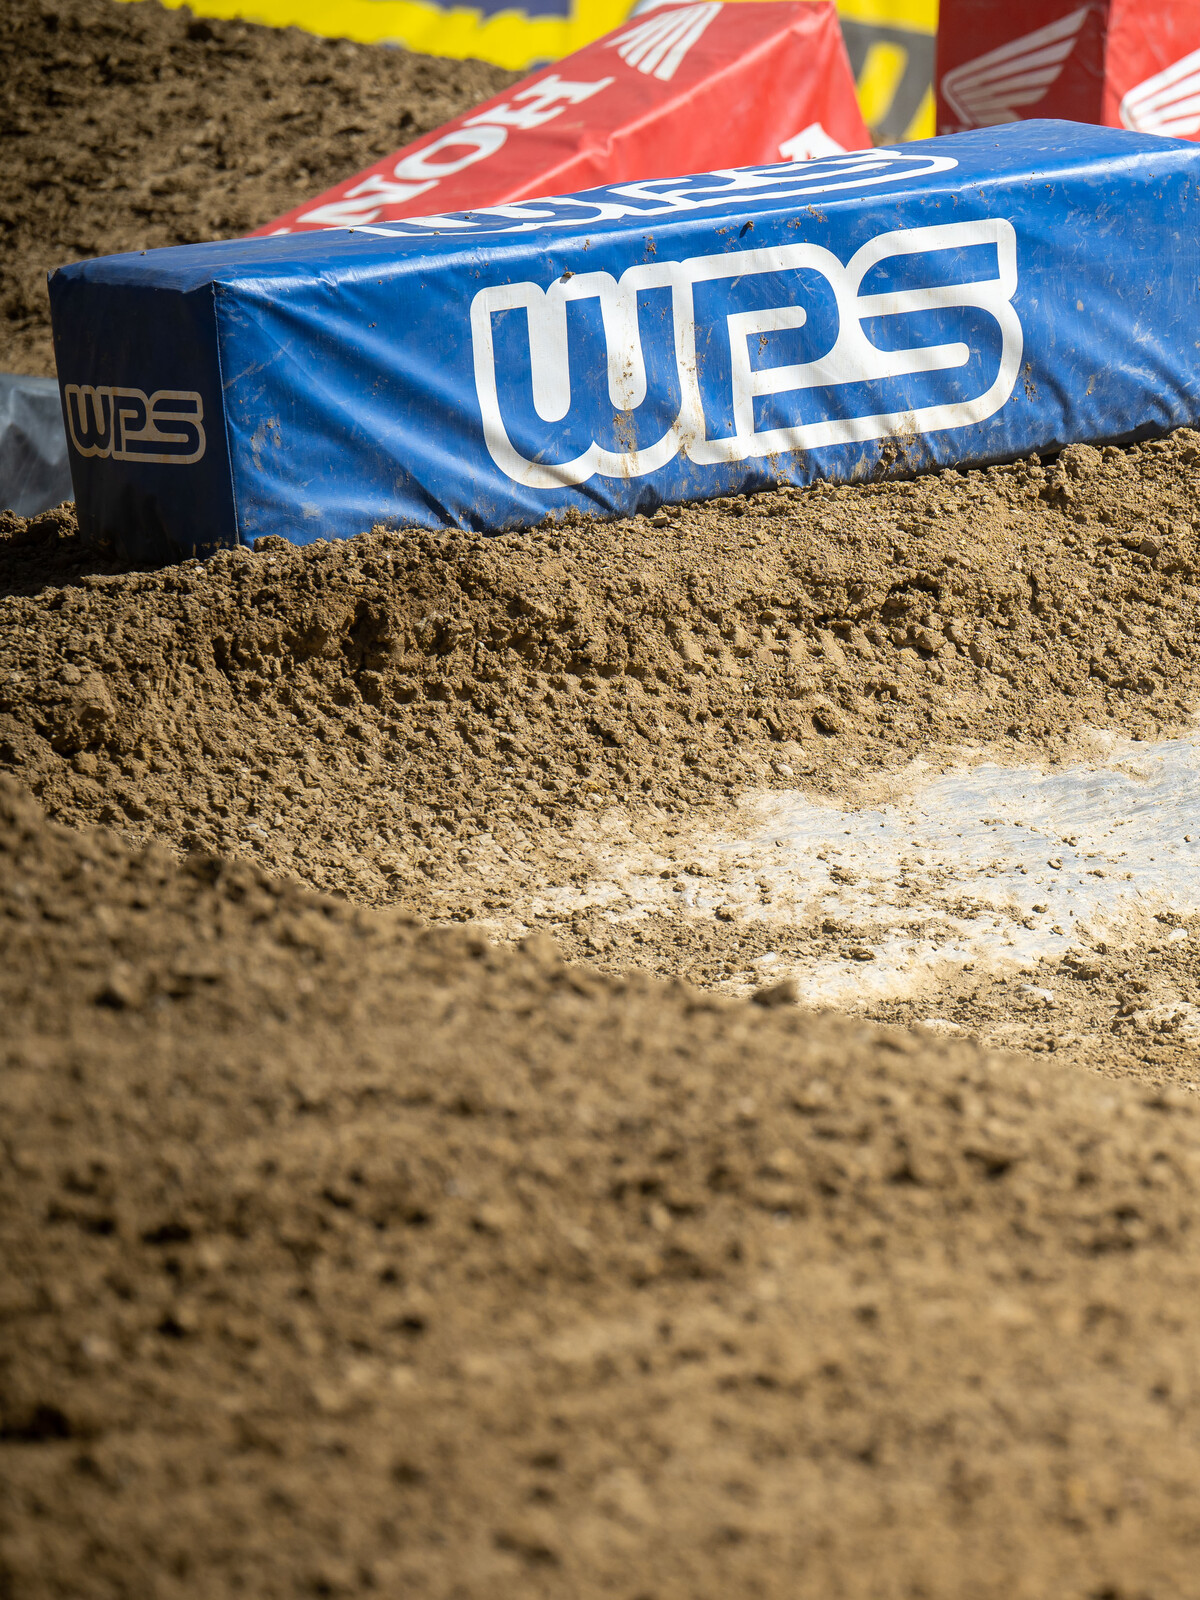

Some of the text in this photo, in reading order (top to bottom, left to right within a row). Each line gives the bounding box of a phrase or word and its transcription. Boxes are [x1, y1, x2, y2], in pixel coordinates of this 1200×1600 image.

[269, 74, 616, 236] HON
[64, 384, 207, 465] WPS
[470, 217, 1023, 489] WPS
